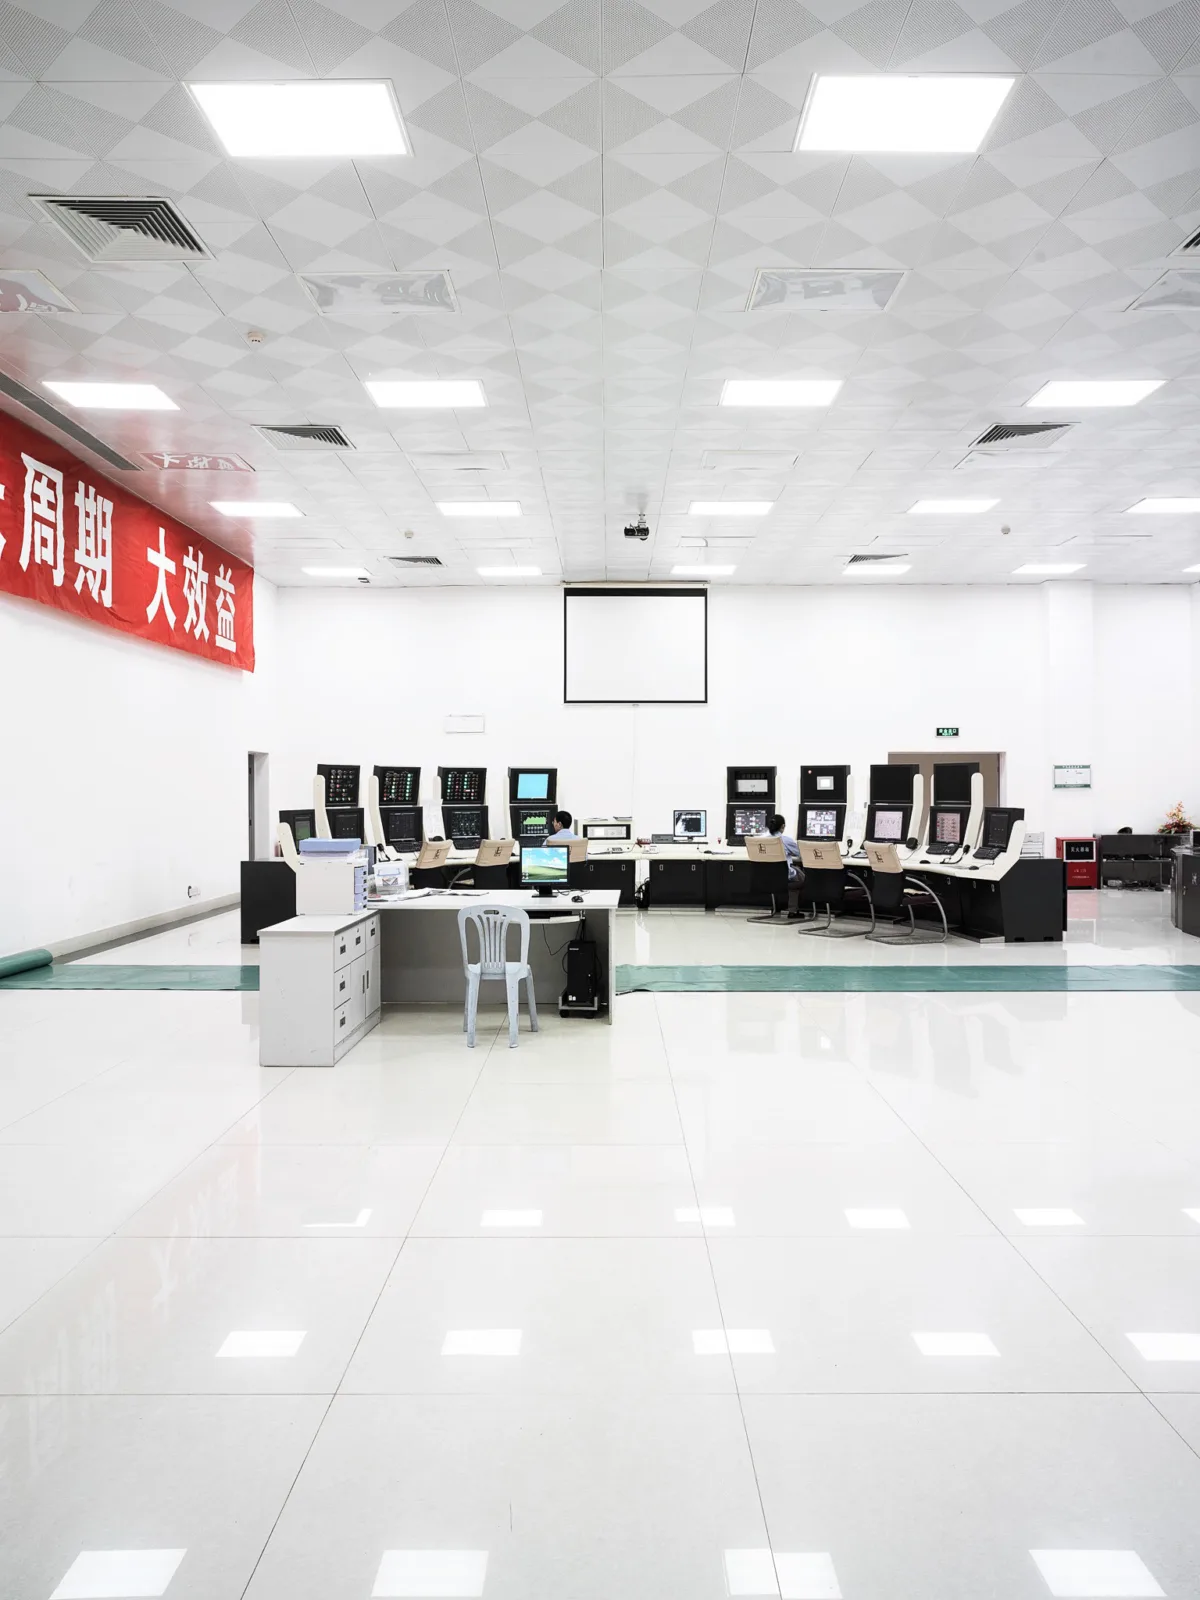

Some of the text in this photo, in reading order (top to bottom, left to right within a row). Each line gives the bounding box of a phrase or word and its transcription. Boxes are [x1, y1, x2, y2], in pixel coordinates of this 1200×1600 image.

[0, 452, 236, 653] 周期 大效益
